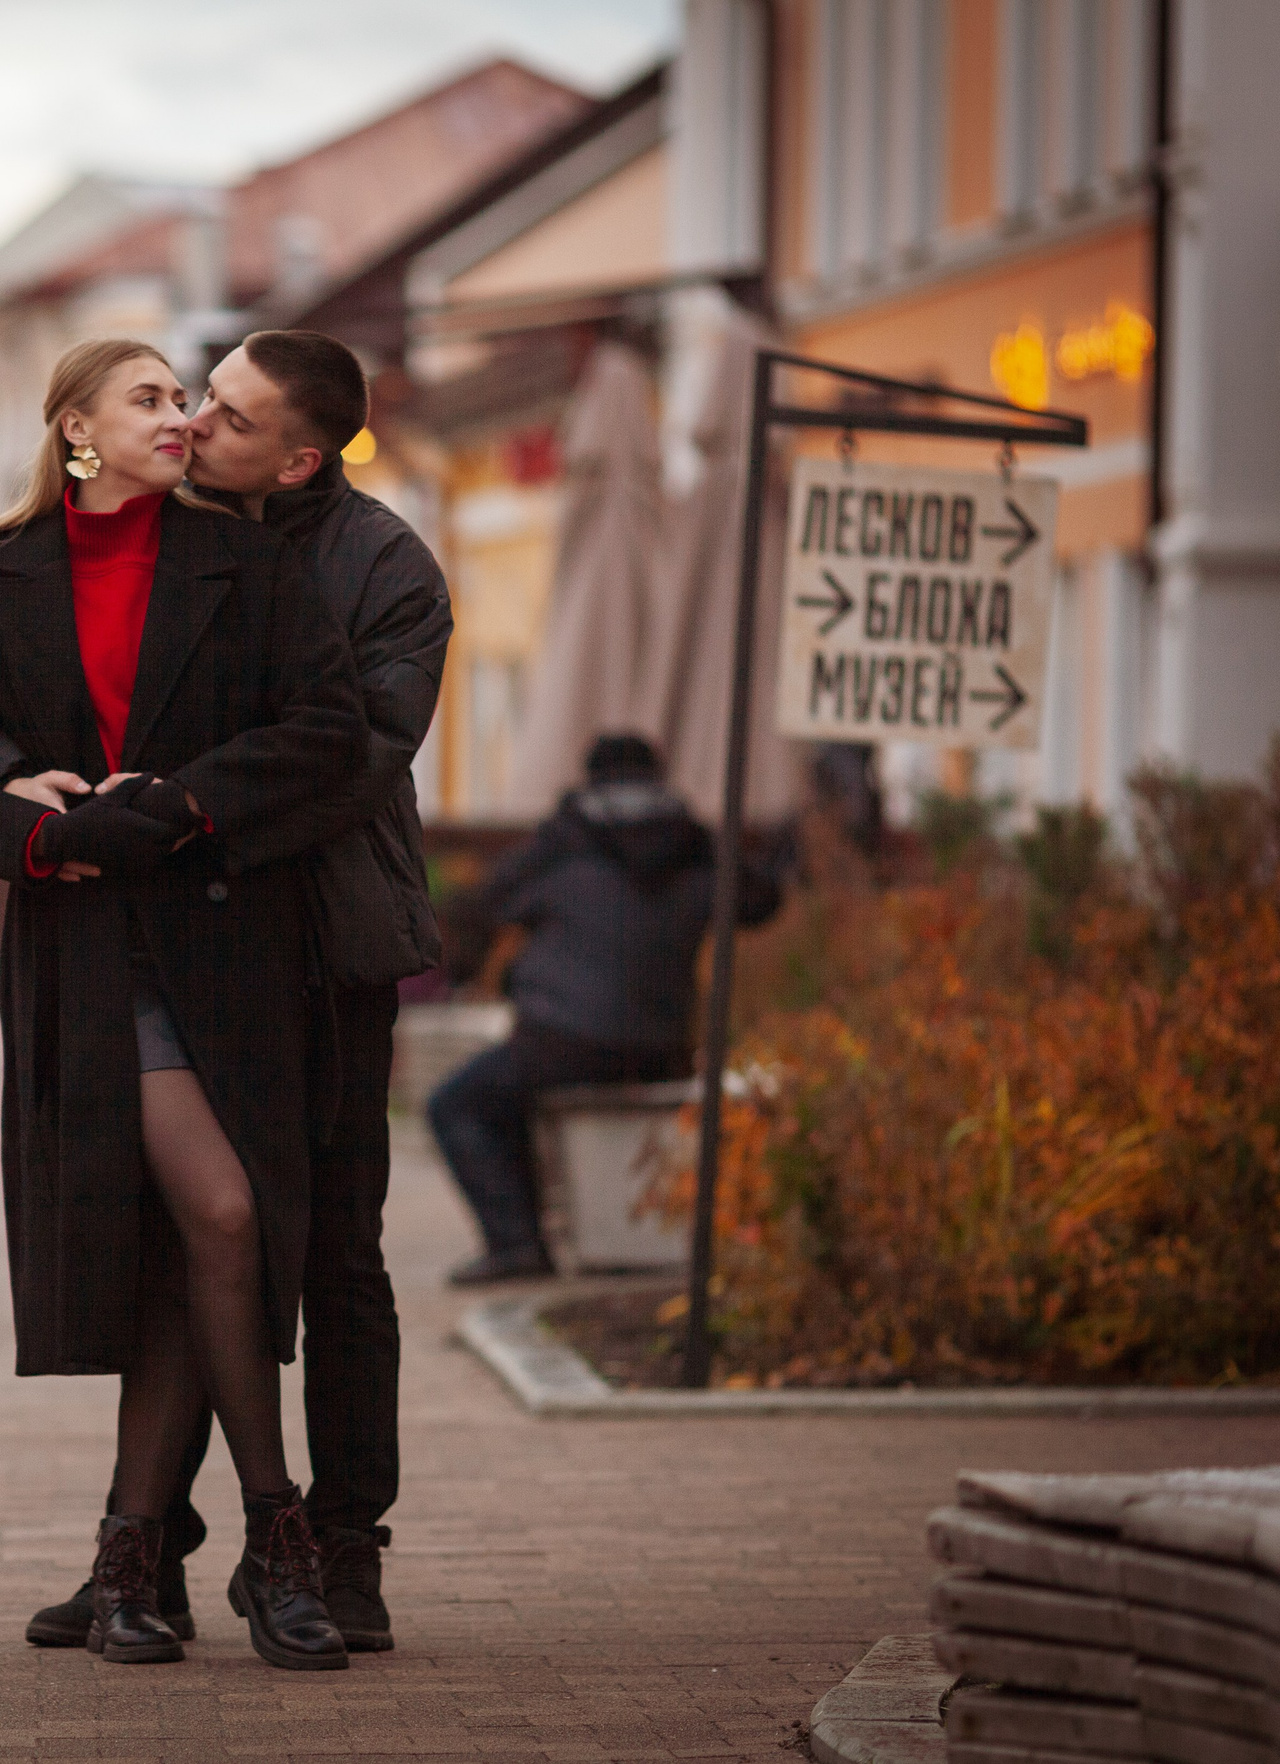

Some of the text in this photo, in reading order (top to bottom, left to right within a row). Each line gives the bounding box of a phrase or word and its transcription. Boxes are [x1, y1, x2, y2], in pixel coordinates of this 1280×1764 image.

[801, 486, 974, 563] ЛЕСКОВ
[865, 572, 1011, 647] БЛОХА
[809, 650, 962, 727] МУЗЕЙ
